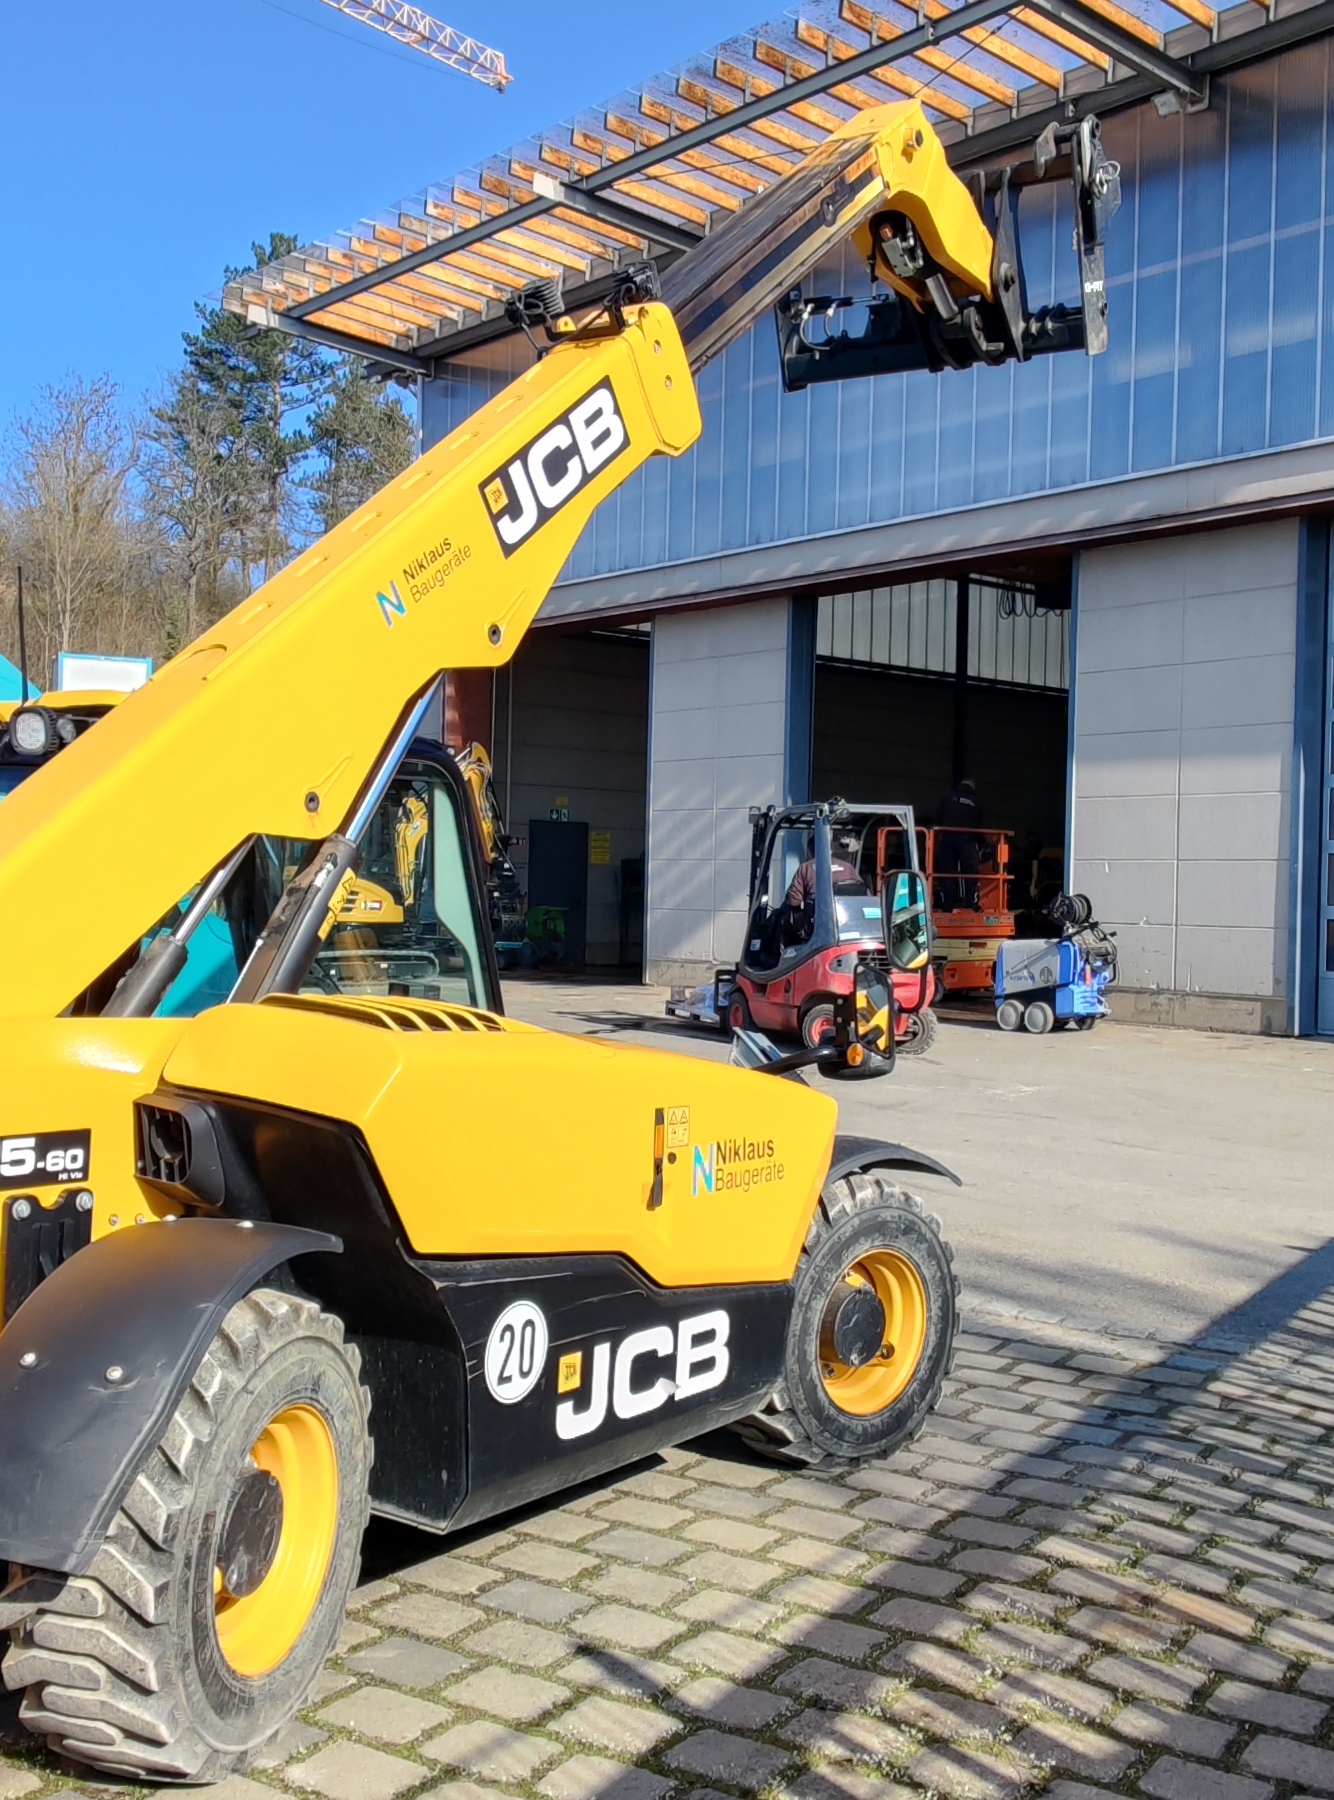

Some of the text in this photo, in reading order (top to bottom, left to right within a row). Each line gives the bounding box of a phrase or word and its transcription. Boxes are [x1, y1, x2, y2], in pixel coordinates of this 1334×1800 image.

[497, 388, 626, 545] JCB
[403, 538, 452, 585] Niklaus
[410, 545, 472, 603] Baugeräte
[715, 1160, 785, 1192] Baugeräte
[716, 1137, 774, 1166] Niklaus
[497, 1319, 536, 1386] 20
[556, 1310, 730, 1440] JCB
